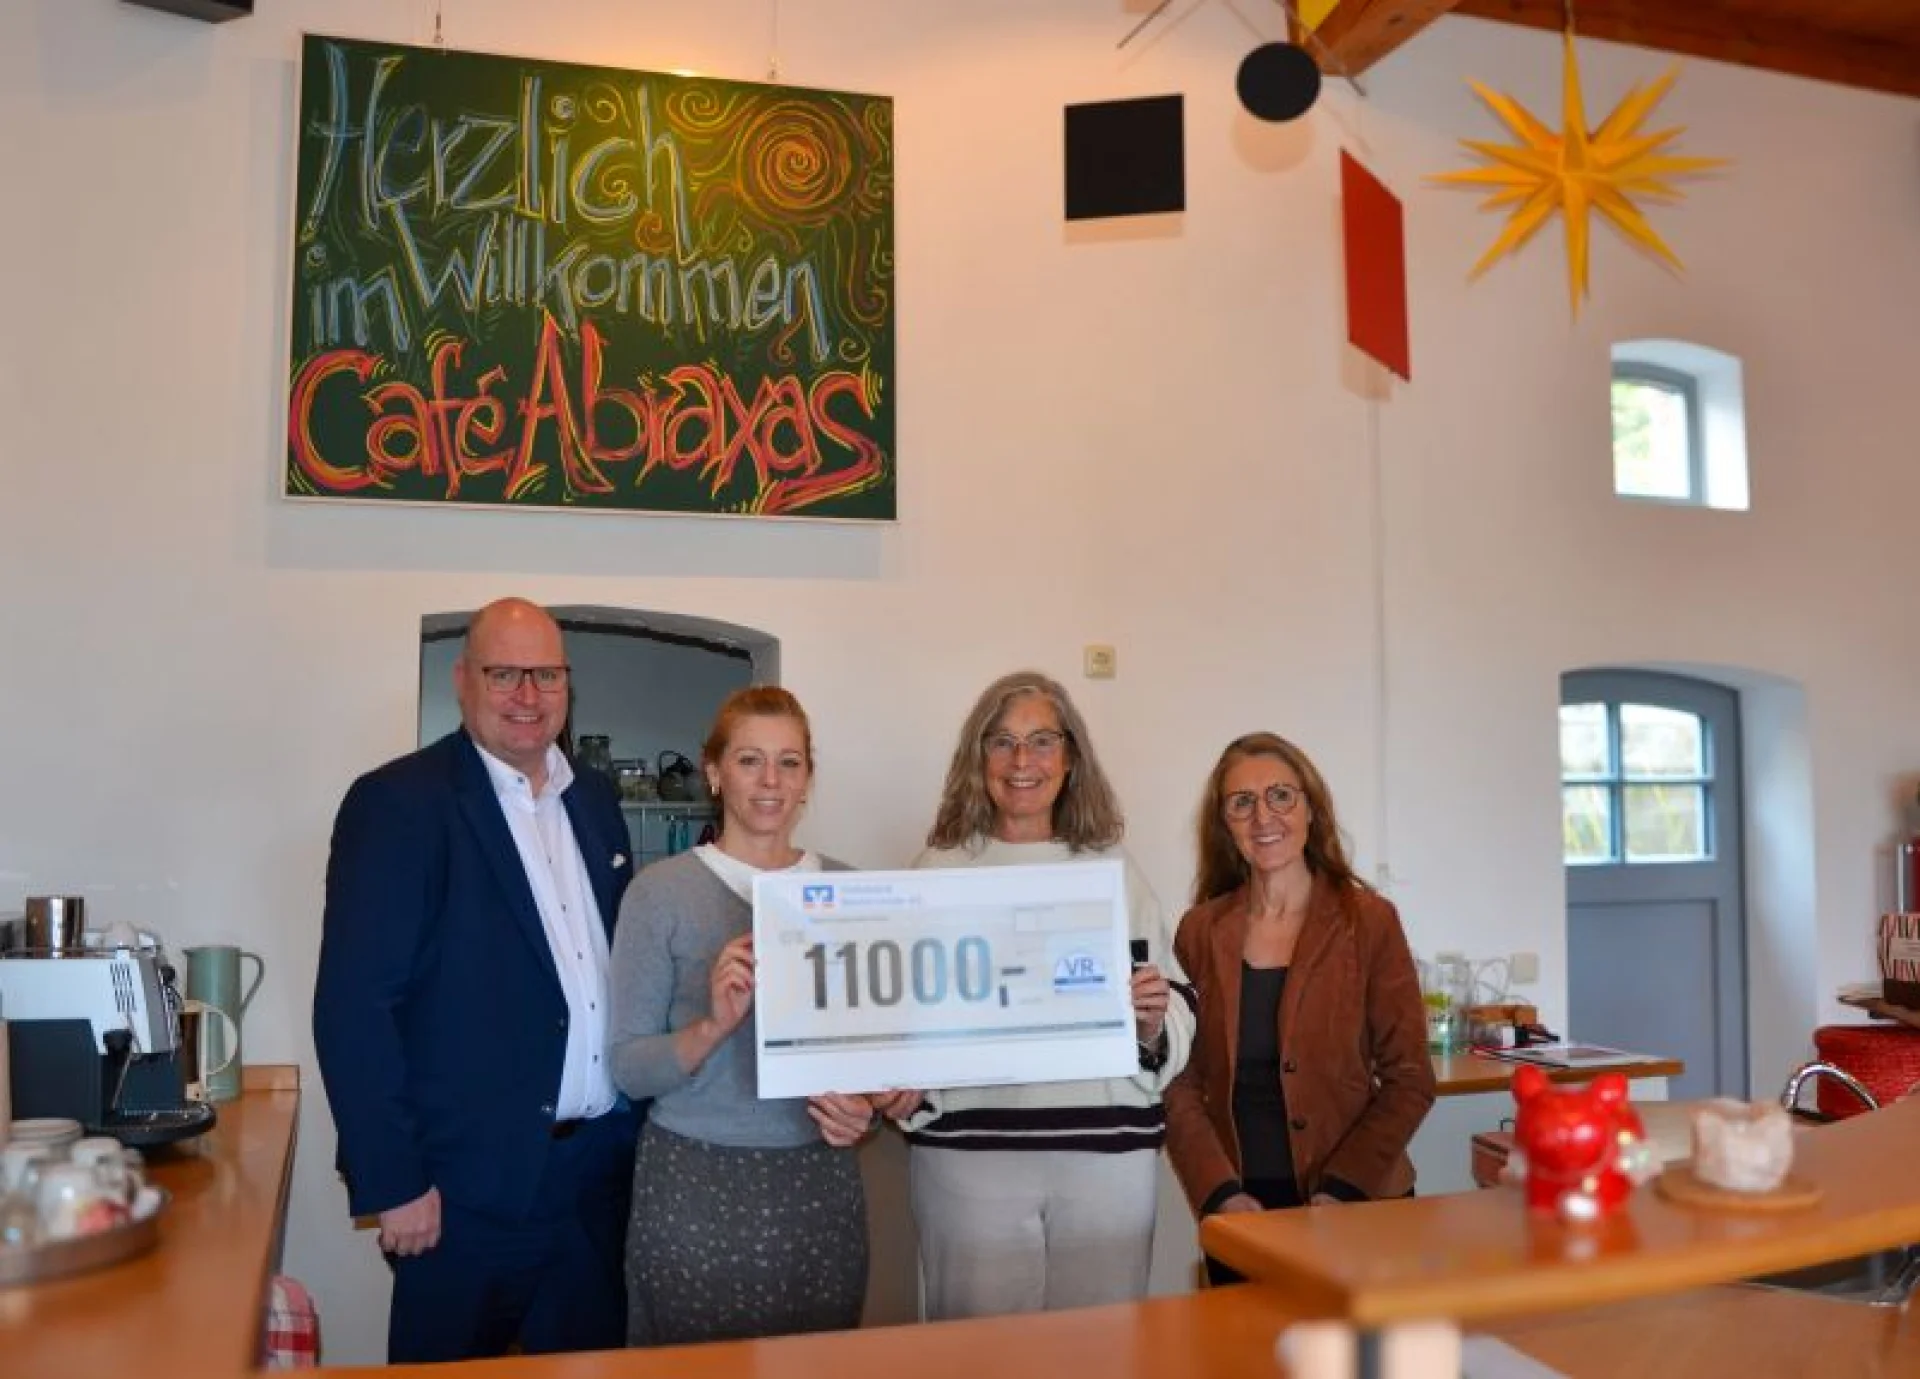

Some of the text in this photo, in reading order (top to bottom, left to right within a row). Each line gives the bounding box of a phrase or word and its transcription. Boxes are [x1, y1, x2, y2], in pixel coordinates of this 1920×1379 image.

[302, 42, 700, 262] Herzlich
[306, 243, 409, 353] im
[377, 203, 828, 363] Willkommen
[288, 308, 882, 514] Café Abraxas
[1063, 957, 1095, 977] VR
